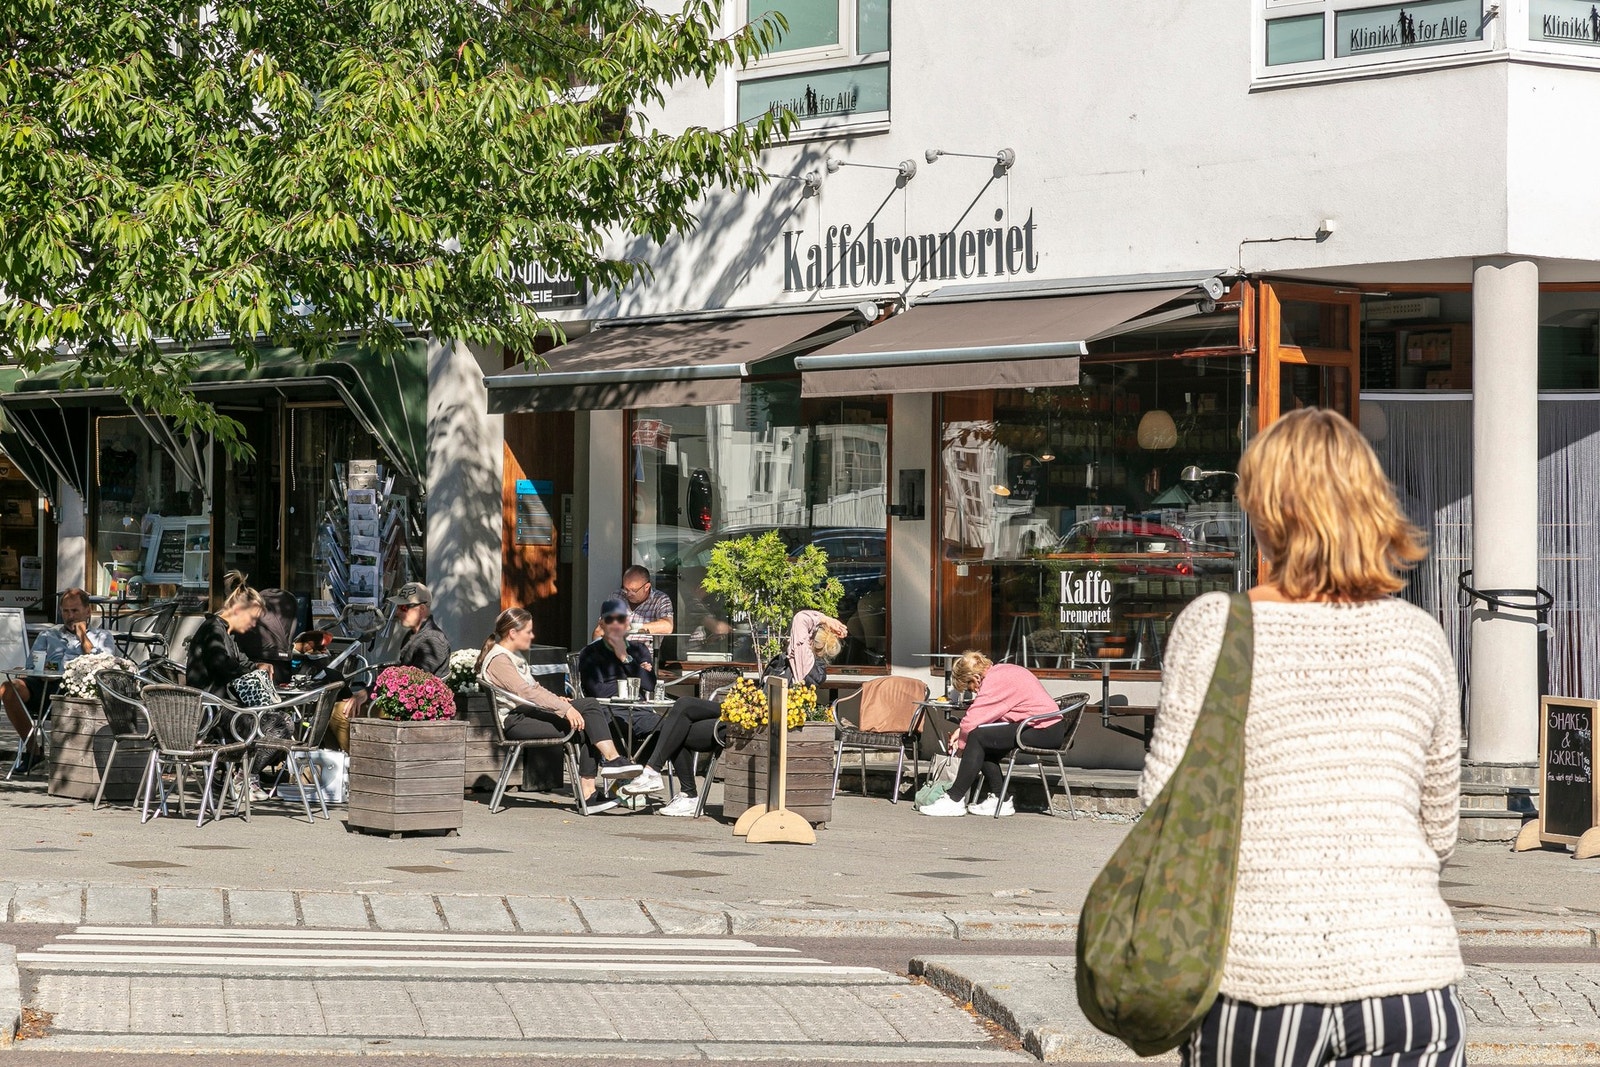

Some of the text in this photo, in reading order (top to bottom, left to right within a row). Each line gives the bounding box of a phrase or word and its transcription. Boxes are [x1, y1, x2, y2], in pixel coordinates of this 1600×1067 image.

[1351, 15, 1467, 48] Klinikk for Alle
[1543, 14, 1590, 39] Klinikk
[820, 94, 836, 112] for
[837, 92, 857, 110] Alle
[782, 207, 1039, 293] Kaffebrenneriet
[1059, 570, 1112, 605] Kaffe
[1059, 605, 1112, 623] brenneriet
[1549, 711, 1589, 732] SHAKES
[1561, 731, 1571, 748] &
[1549, 749, 1584, 768] ISKREM
